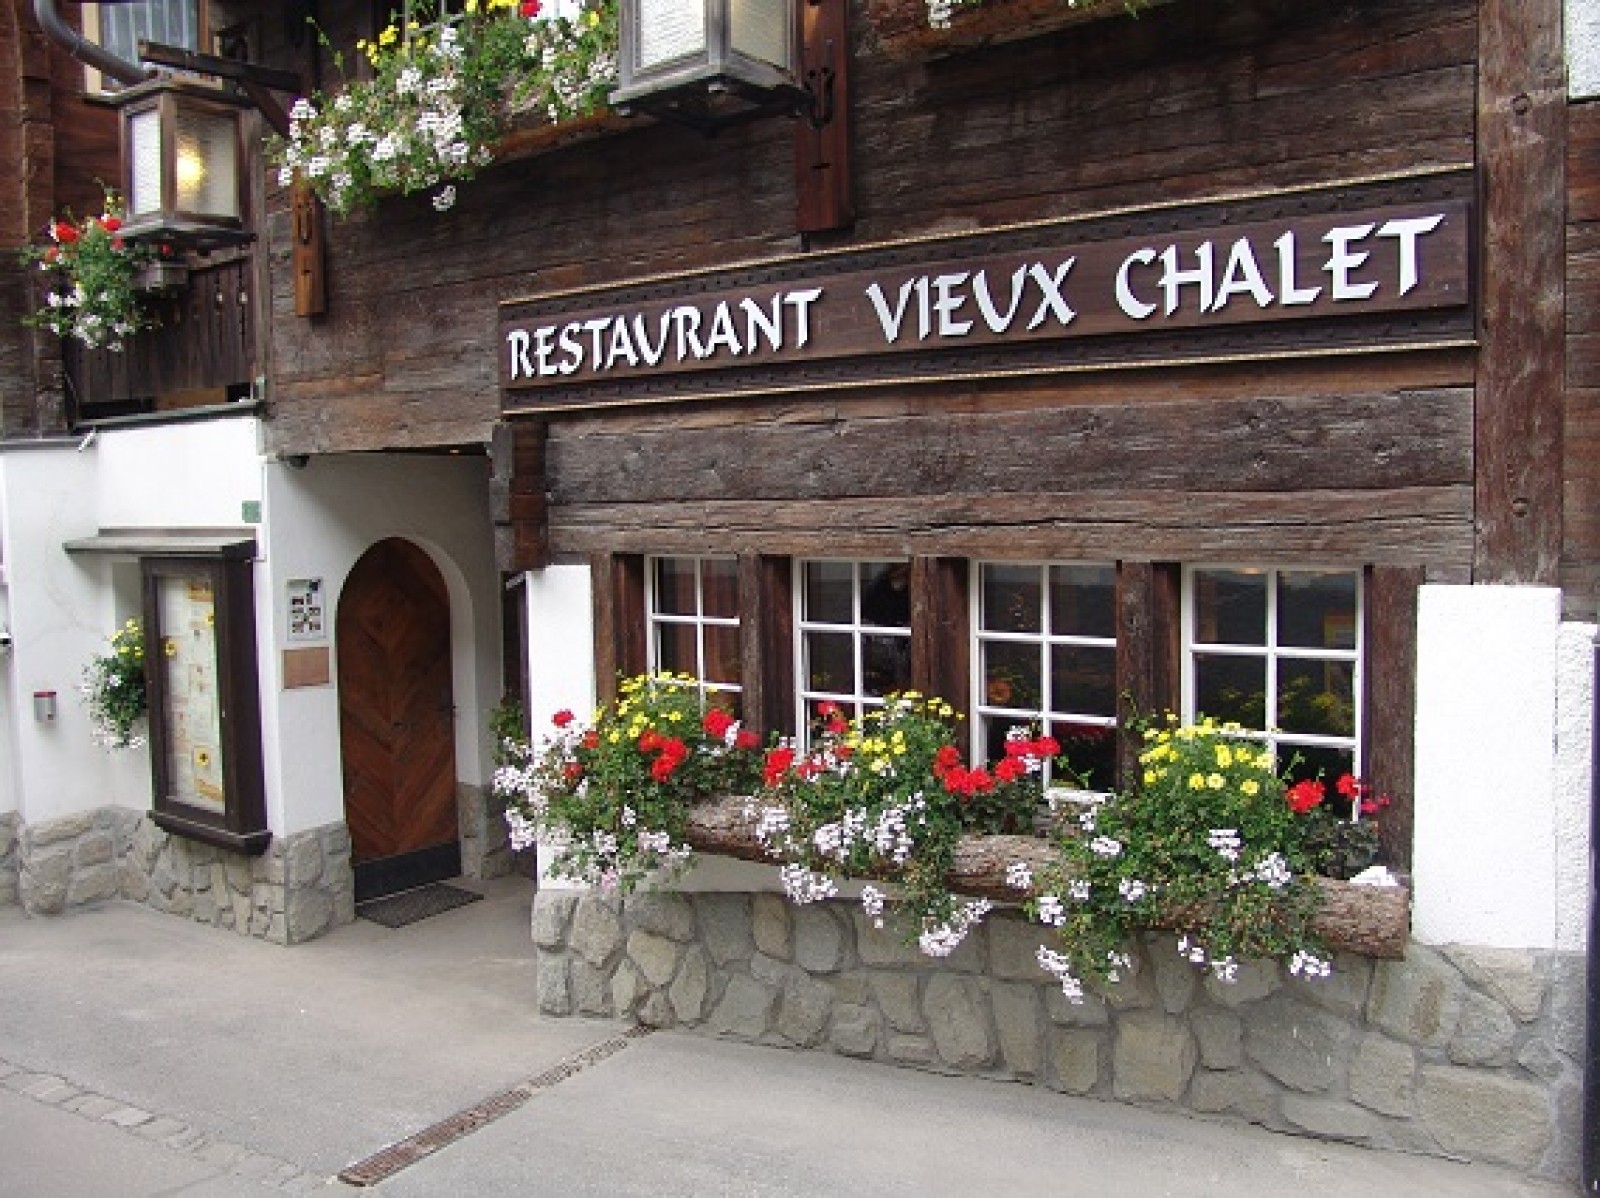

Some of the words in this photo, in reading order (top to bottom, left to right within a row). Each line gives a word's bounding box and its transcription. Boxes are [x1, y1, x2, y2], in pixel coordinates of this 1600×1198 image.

[506, 286, 823, 381] RESTAURANT
[865, 255, 1077, 344] VIEUX
[1114, 213, 1446, 320] CHALET
